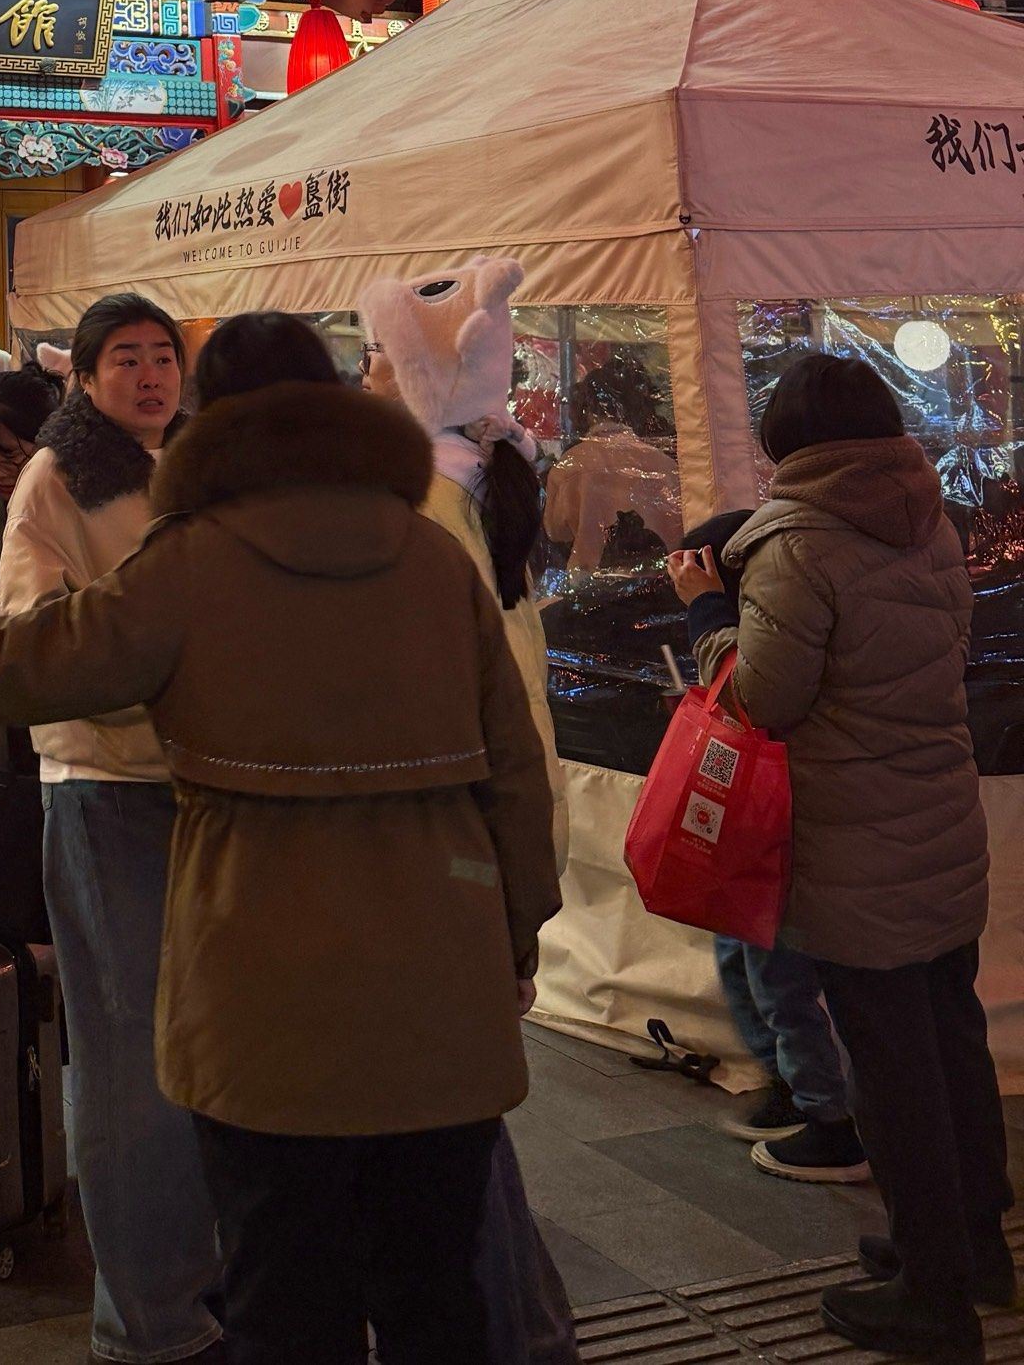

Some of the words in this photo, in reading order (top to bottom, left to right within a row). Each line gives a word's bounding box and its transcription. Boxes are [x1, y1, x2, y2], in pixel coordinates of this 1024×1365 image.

[925, 114, 1024, 174] 我们
[183, 246, 233, 263] WELCOME
[239, 243, 253, 257] TO
[260, 236, 302, 255] GUIJIE
